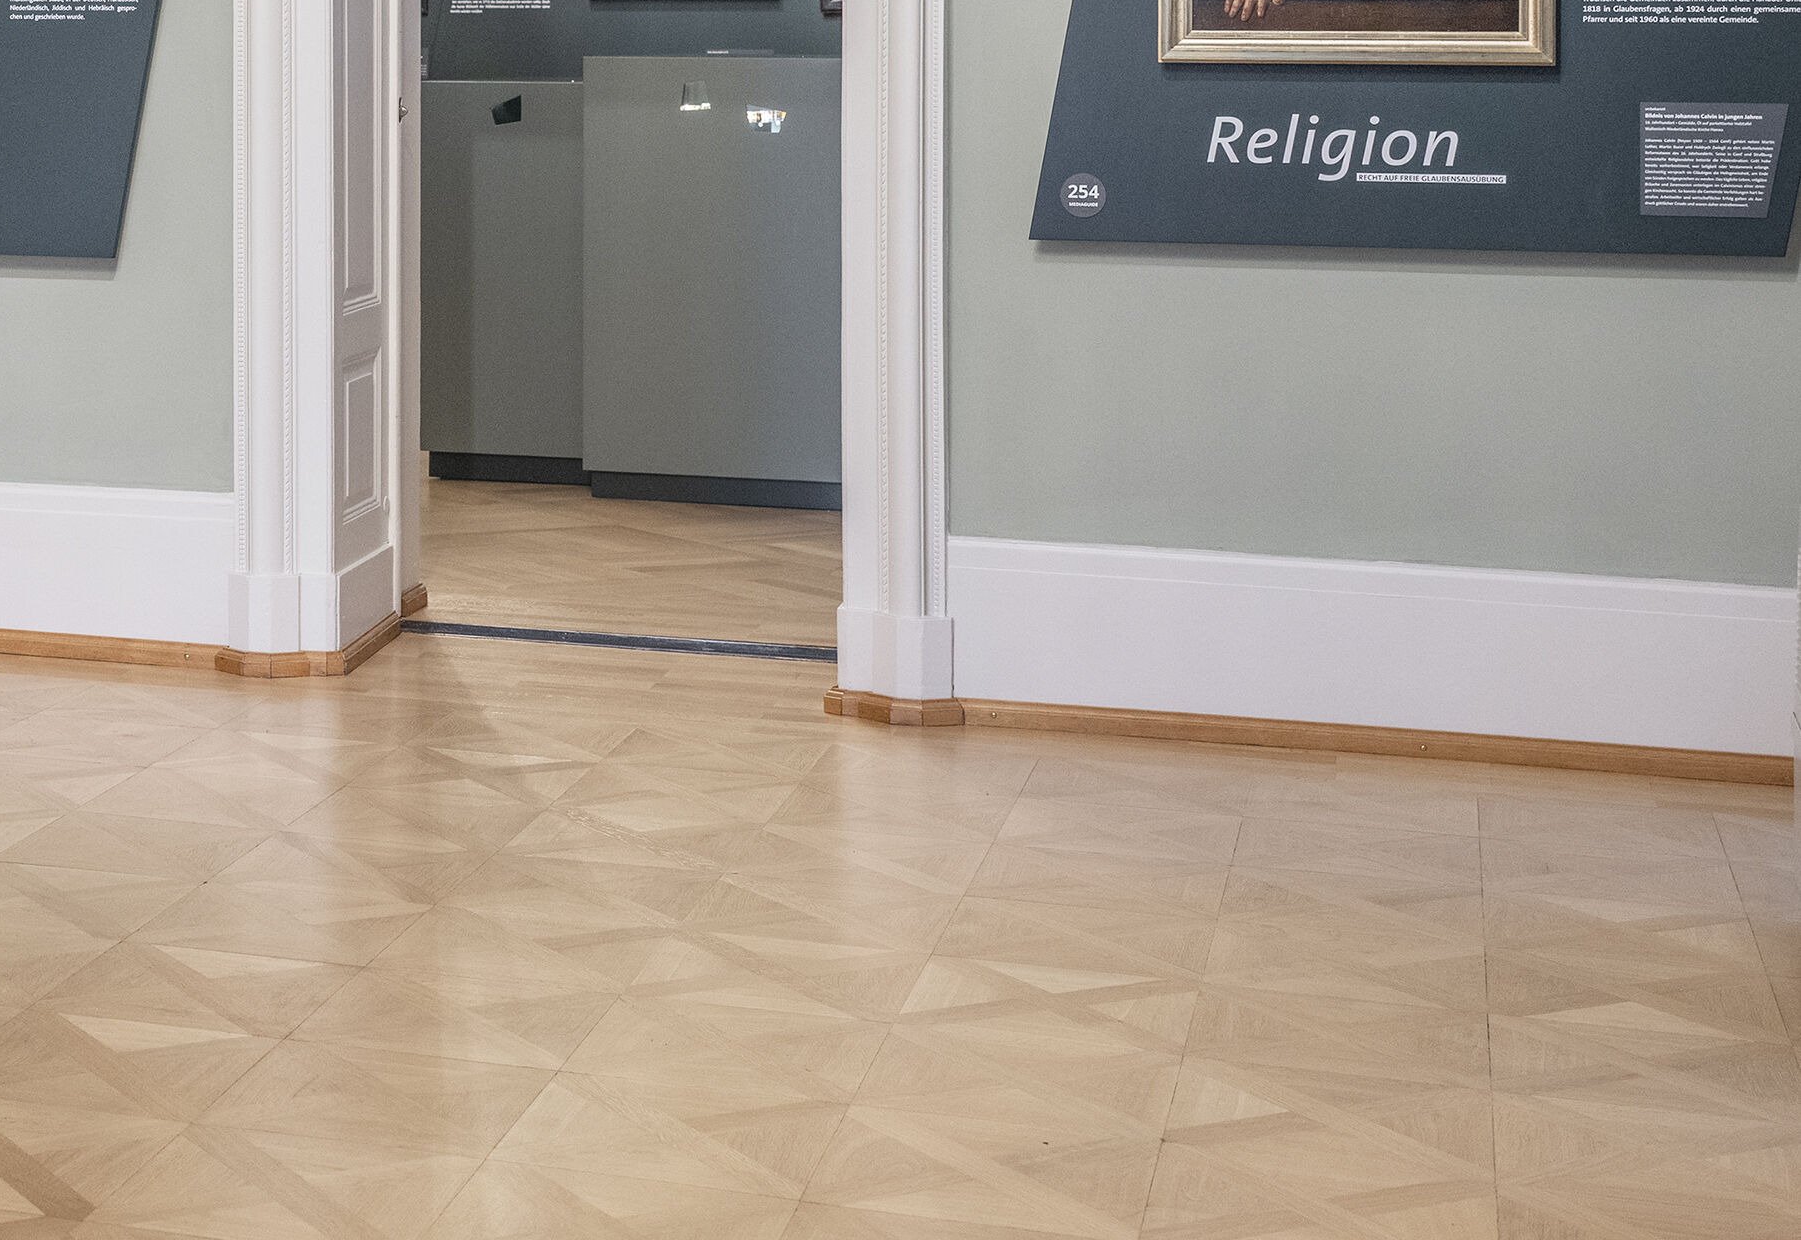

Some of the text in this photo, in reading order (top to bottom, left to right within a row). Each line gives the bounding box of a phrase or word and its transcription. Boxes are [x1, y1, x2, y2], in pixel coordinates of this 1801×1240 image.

[1583, 5, 1601, 13] 1818
[1612, 5, 1672, 14] Glaubensfragen,
[1674, 5, 1684, 13] ab
[1686, 5, 1705, 13] 1924
[1706, 5, 1728, 13] durch
[1730, 5, 1751, 13] einen
[1582, 15, 1608, 23] Pfarrer
[1608, 15, 1624, 23] und
[1624, 15, 1638, 23] seit
[1639, 15, 1659, 23] 1960
[1659, 15, 1670, 23] als
[1670, 15, 1687, 23] eine
[1206, 113, 1459, 181] Religion
[1067, 184, 1100, 199] 254
